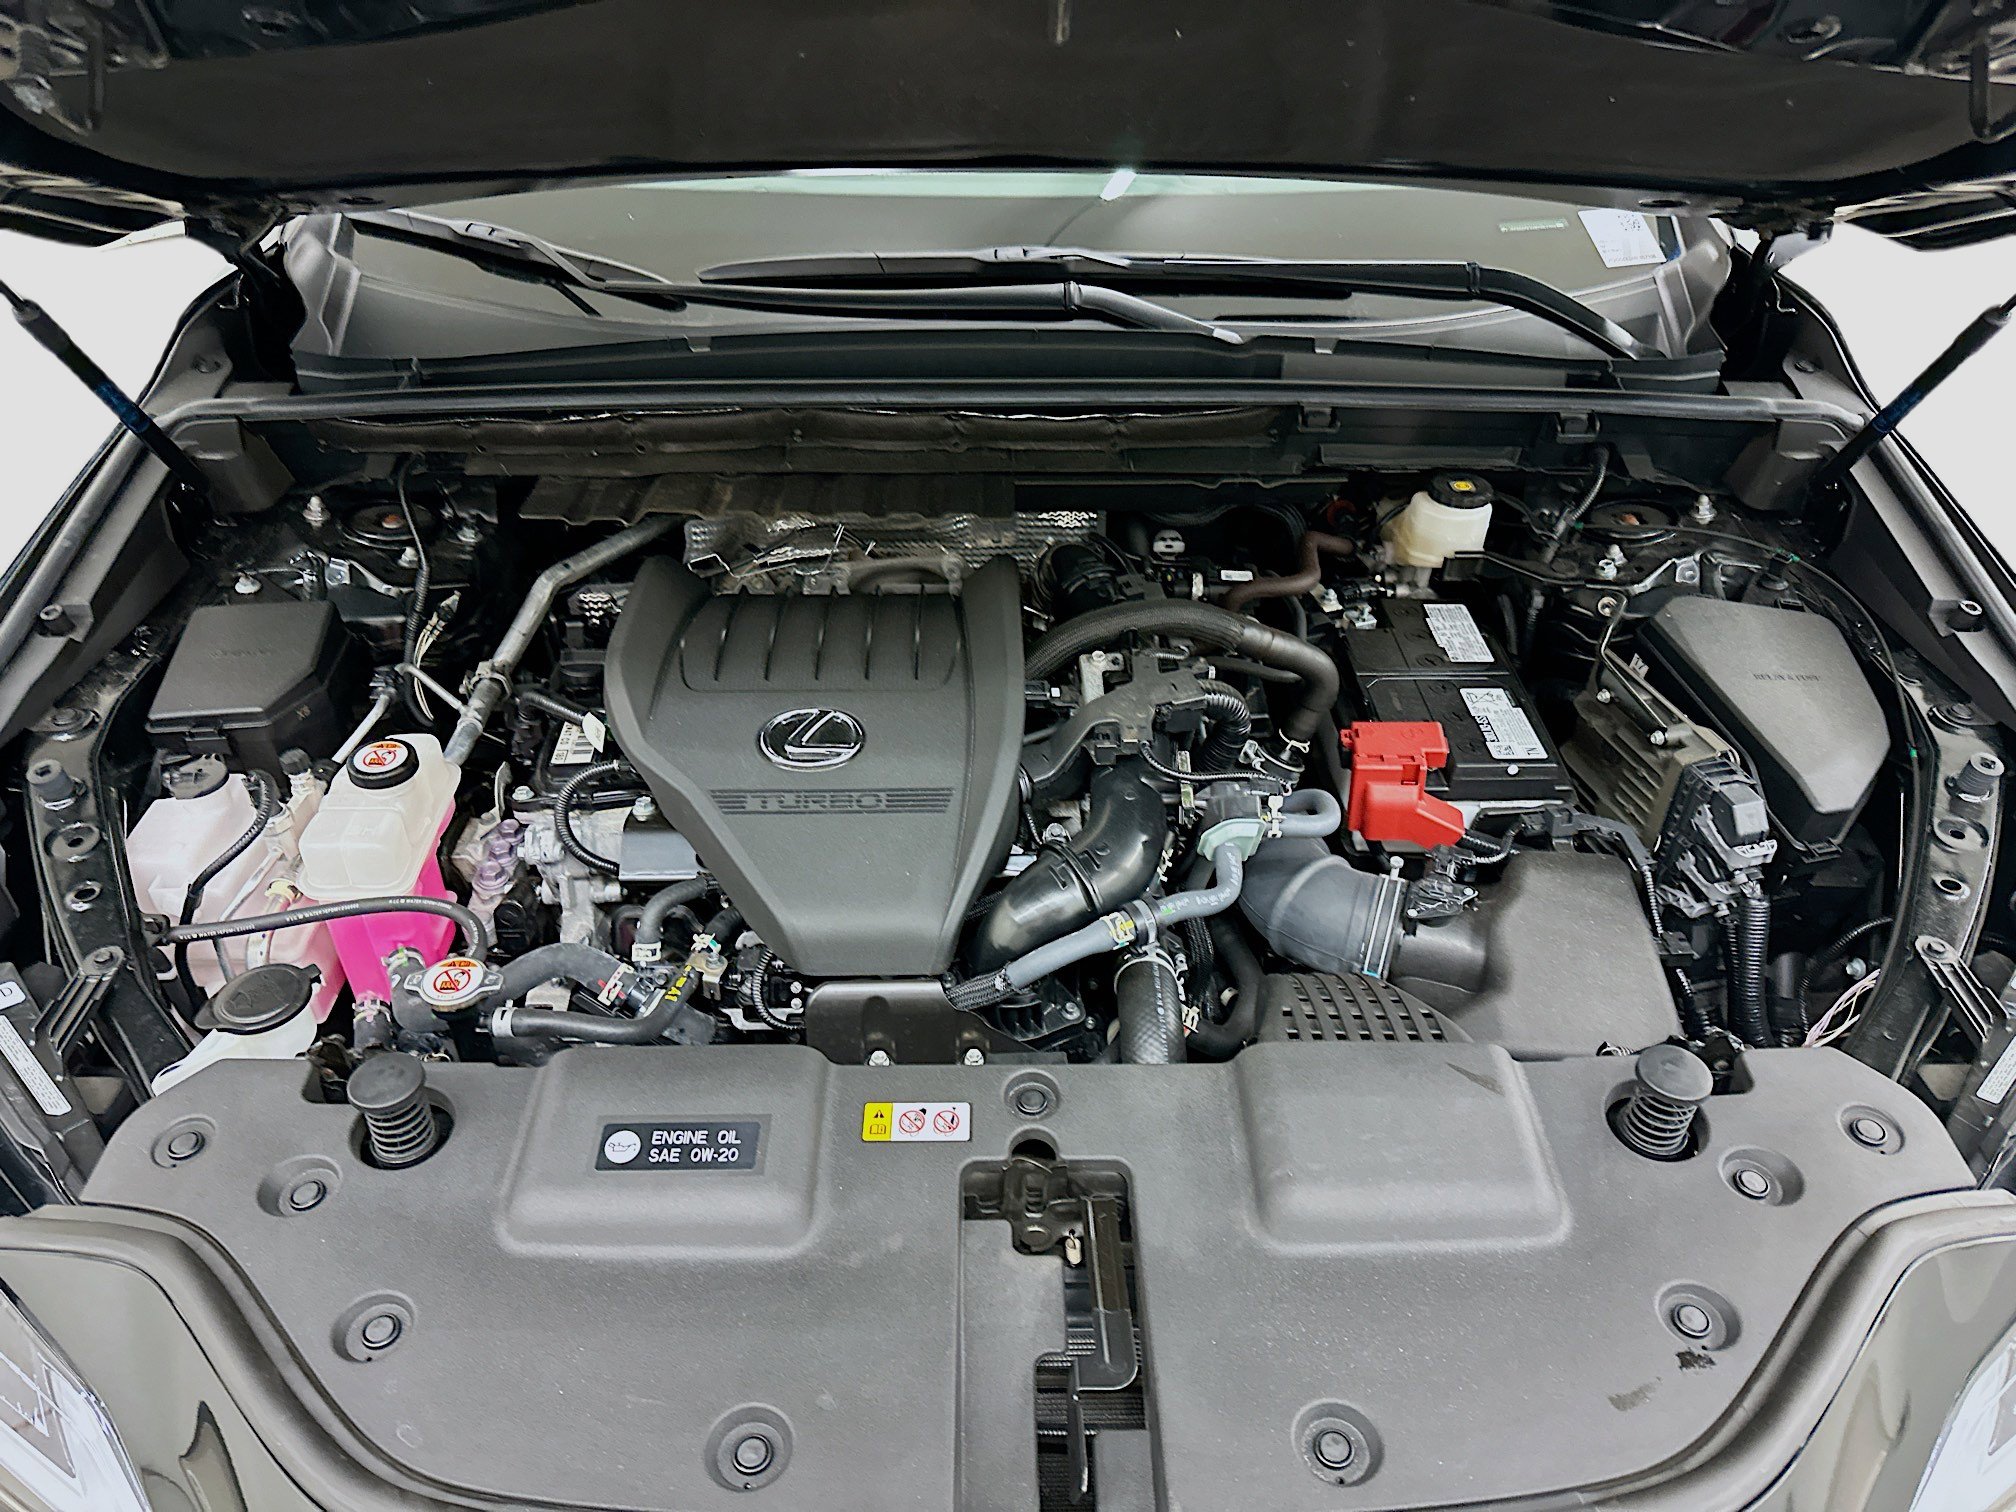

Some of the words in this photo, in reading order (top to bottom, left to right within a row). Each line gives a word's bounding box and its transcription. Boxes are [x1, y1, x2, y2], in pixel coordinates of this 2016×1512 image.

[750, 793, 882, 809] TURBO
[651, 1130, 709, 1145] ENGINE
[717, 1130, 742, 1145] OIL
[648, 1147, 681, 1162] SAE
[689, 1147, 740, 1162] 0W-20
